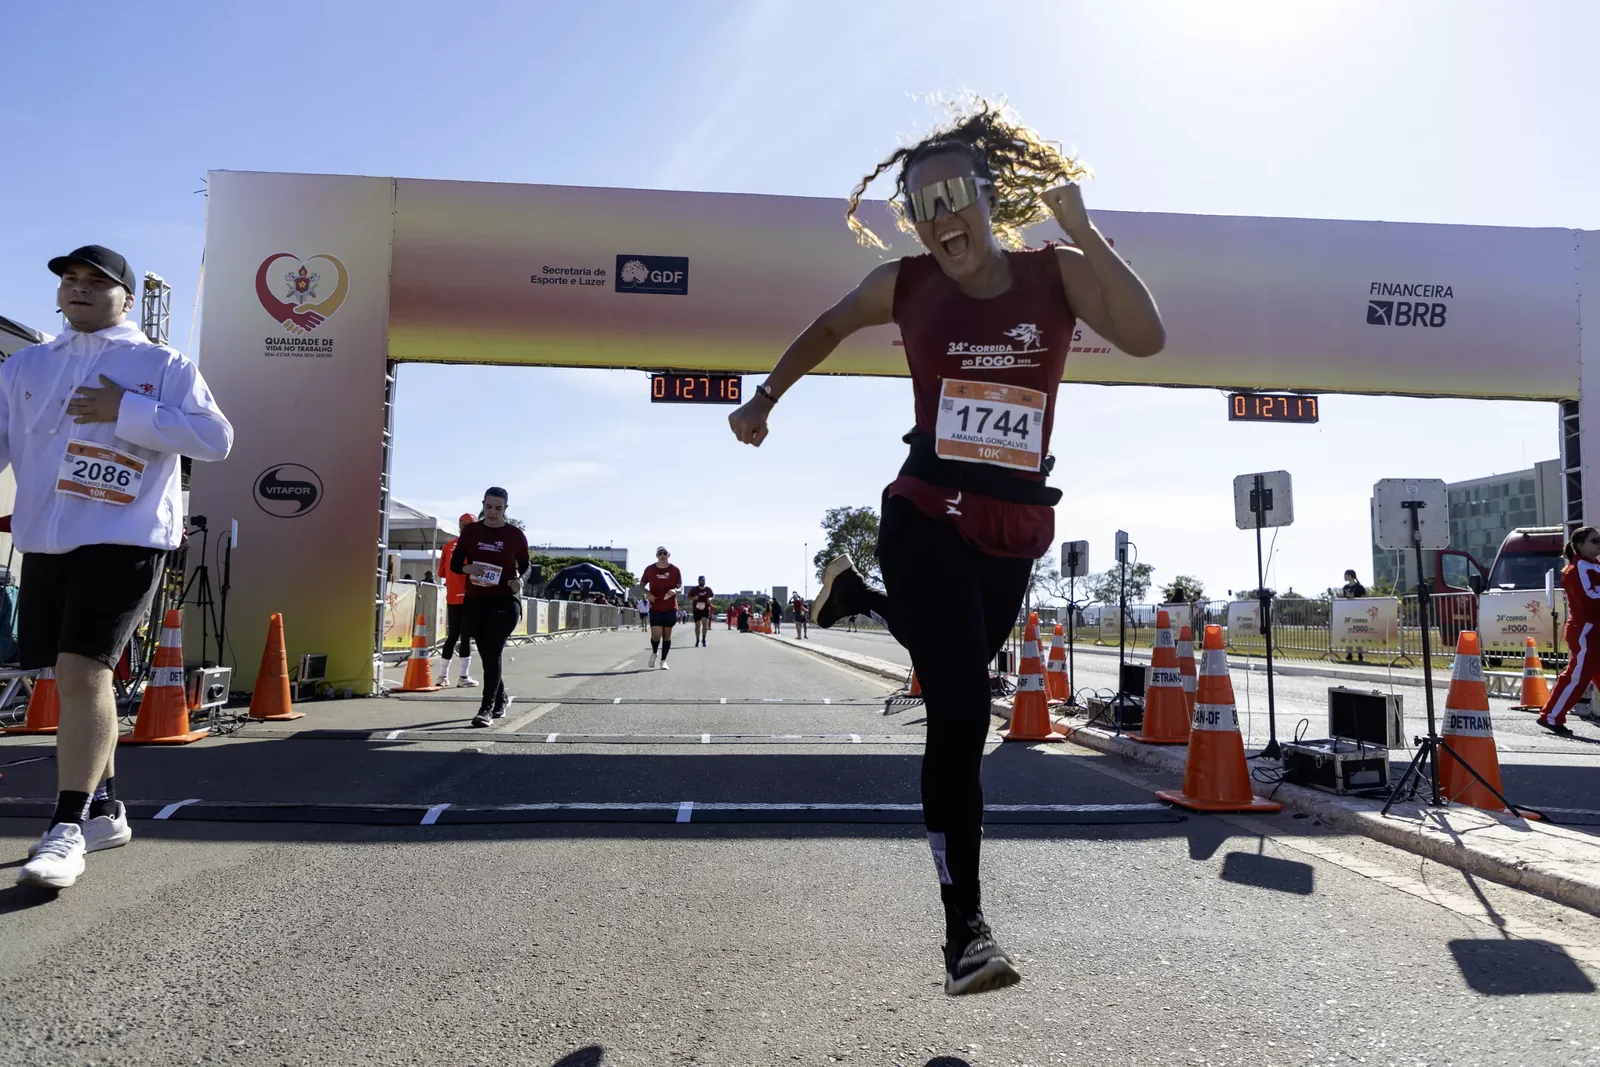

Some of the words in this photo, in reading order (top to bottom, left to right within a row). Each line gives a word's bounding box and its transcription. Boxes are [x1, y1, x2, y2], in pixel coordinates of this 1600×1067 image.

[542, 266, 591, 276] Secretaria
[593, 267, 606, 277] de
[650, 270, 684, 284] GDF
[530, 275, 568, 286] Esporte
[579, 277, 606, 286] Lazer
[1370, 282, 1454, 299] FINANCEIRA
[1394, 301, 1447, 328] BRB
[265, 337, 320, 346] QUALIDADE
[322, 338, 334, 346] DE
[969, 344, 1013, 353] CORRIDA
[975, 355, 1015, 367] FOGO
[957, 405, 1030, 441] 1744
[951, 432, 984, 444] AMANDA
[985, 437, 1029, 450] GONÇALVES
[978, 447, 1001, 460] 10K
[72, 460, 131, 487] 2086
[89, 488, 107, 499] 10K
[266, 486, 311, 495] VITAFOR
[1507, 624, 1528, 632] FOGO
